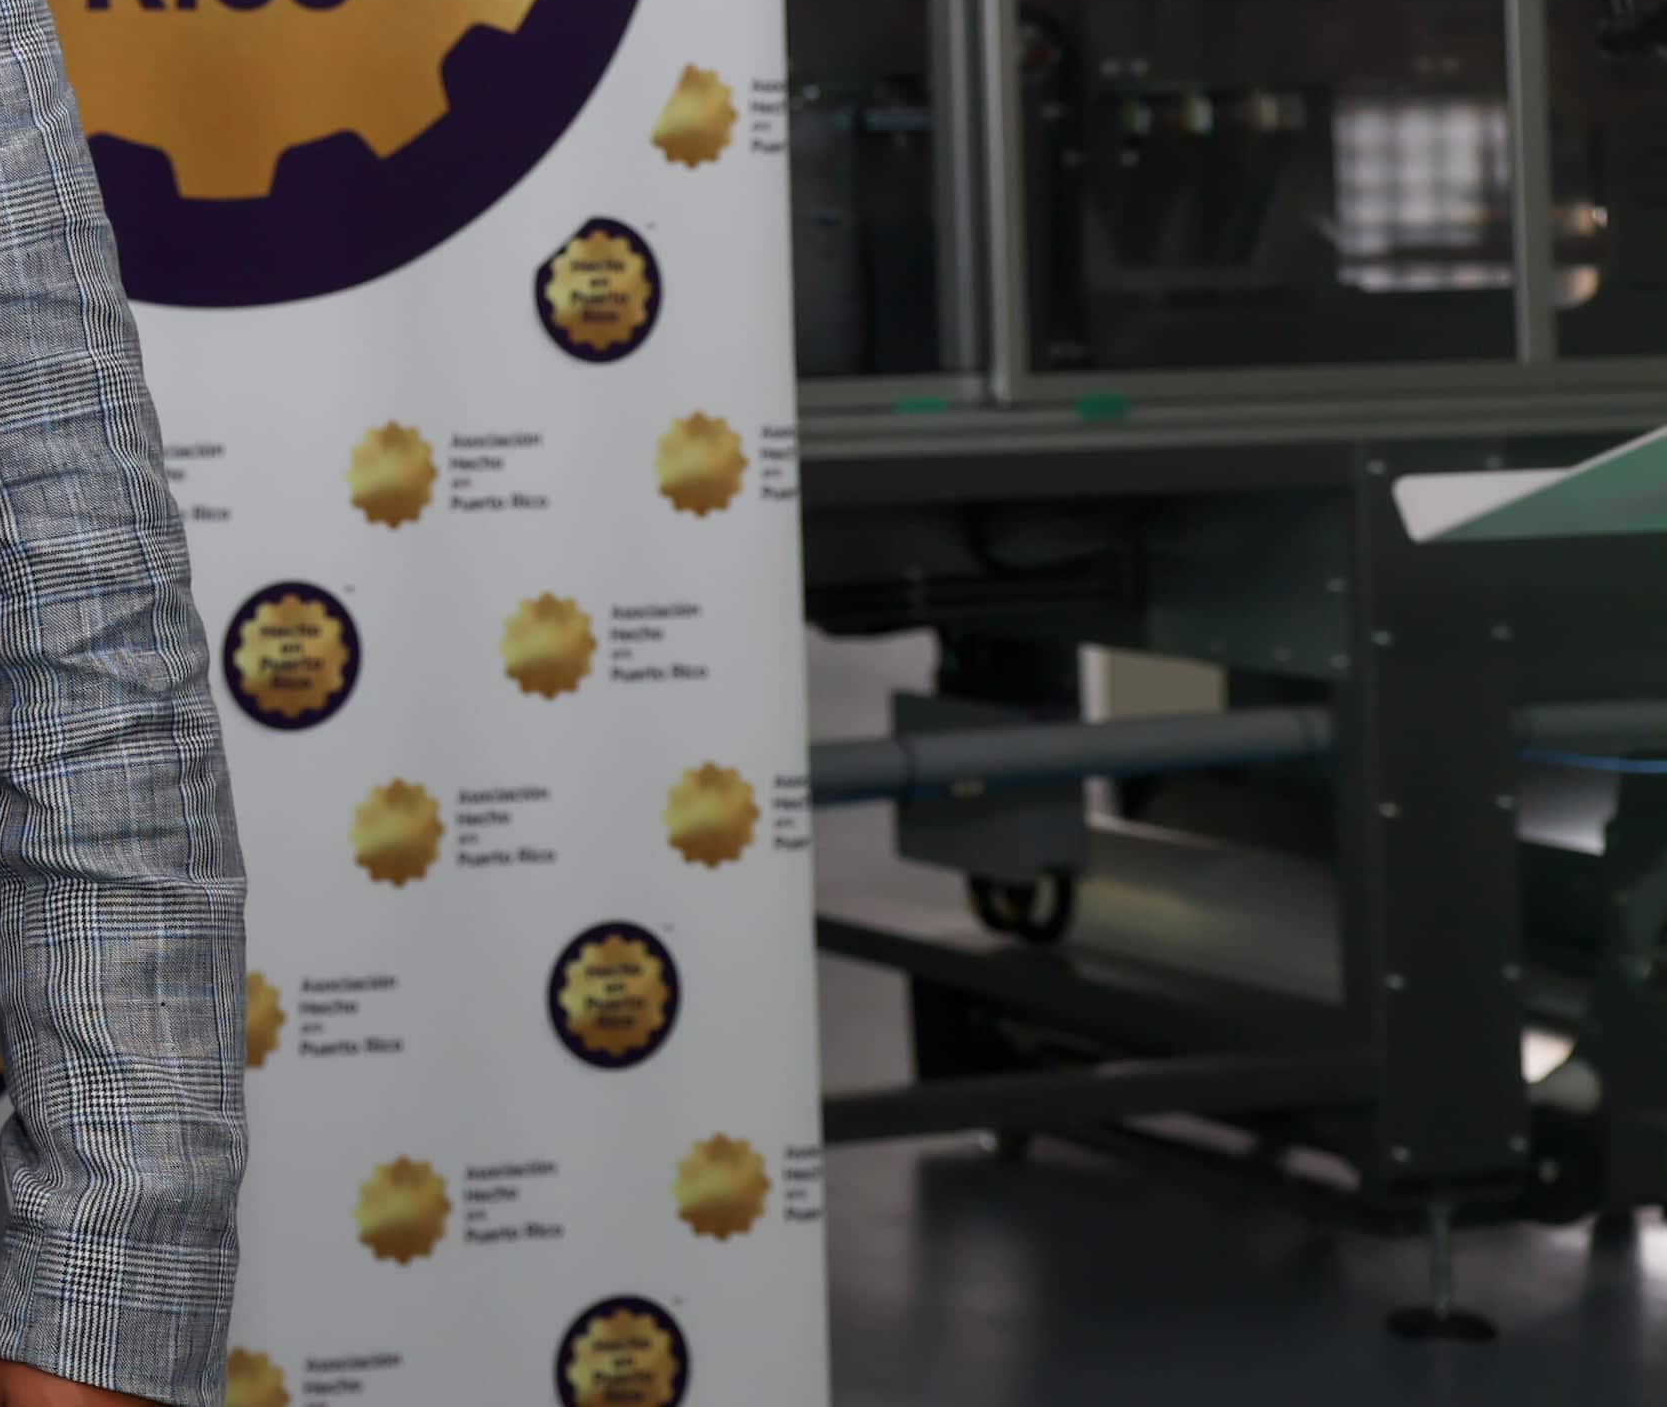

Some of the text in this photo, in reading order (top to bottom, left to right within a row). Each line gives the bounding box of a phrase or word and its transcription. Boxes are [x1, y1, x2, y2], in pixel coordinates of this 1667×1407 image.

[450, 457, 502, 469] Hecho
[450, 492, 548, 510] Puerto Rico
[610, 627, 663, 640] Hecho
[610, 662, 708, 680] Puerto Rico
[458, 811, 510, 825] Hecho
[458, 848, 555, 866] Puerto Rico
[299, 1000, 358, 1015] Hecho
[299, 1037, 403, 1056] Puerto Rico
[465, 1187, 518, 1201] Hecho
[466, 1222, 562, 1242] Puerto Rico
[303, 1379, 361, 1393] Hecho
